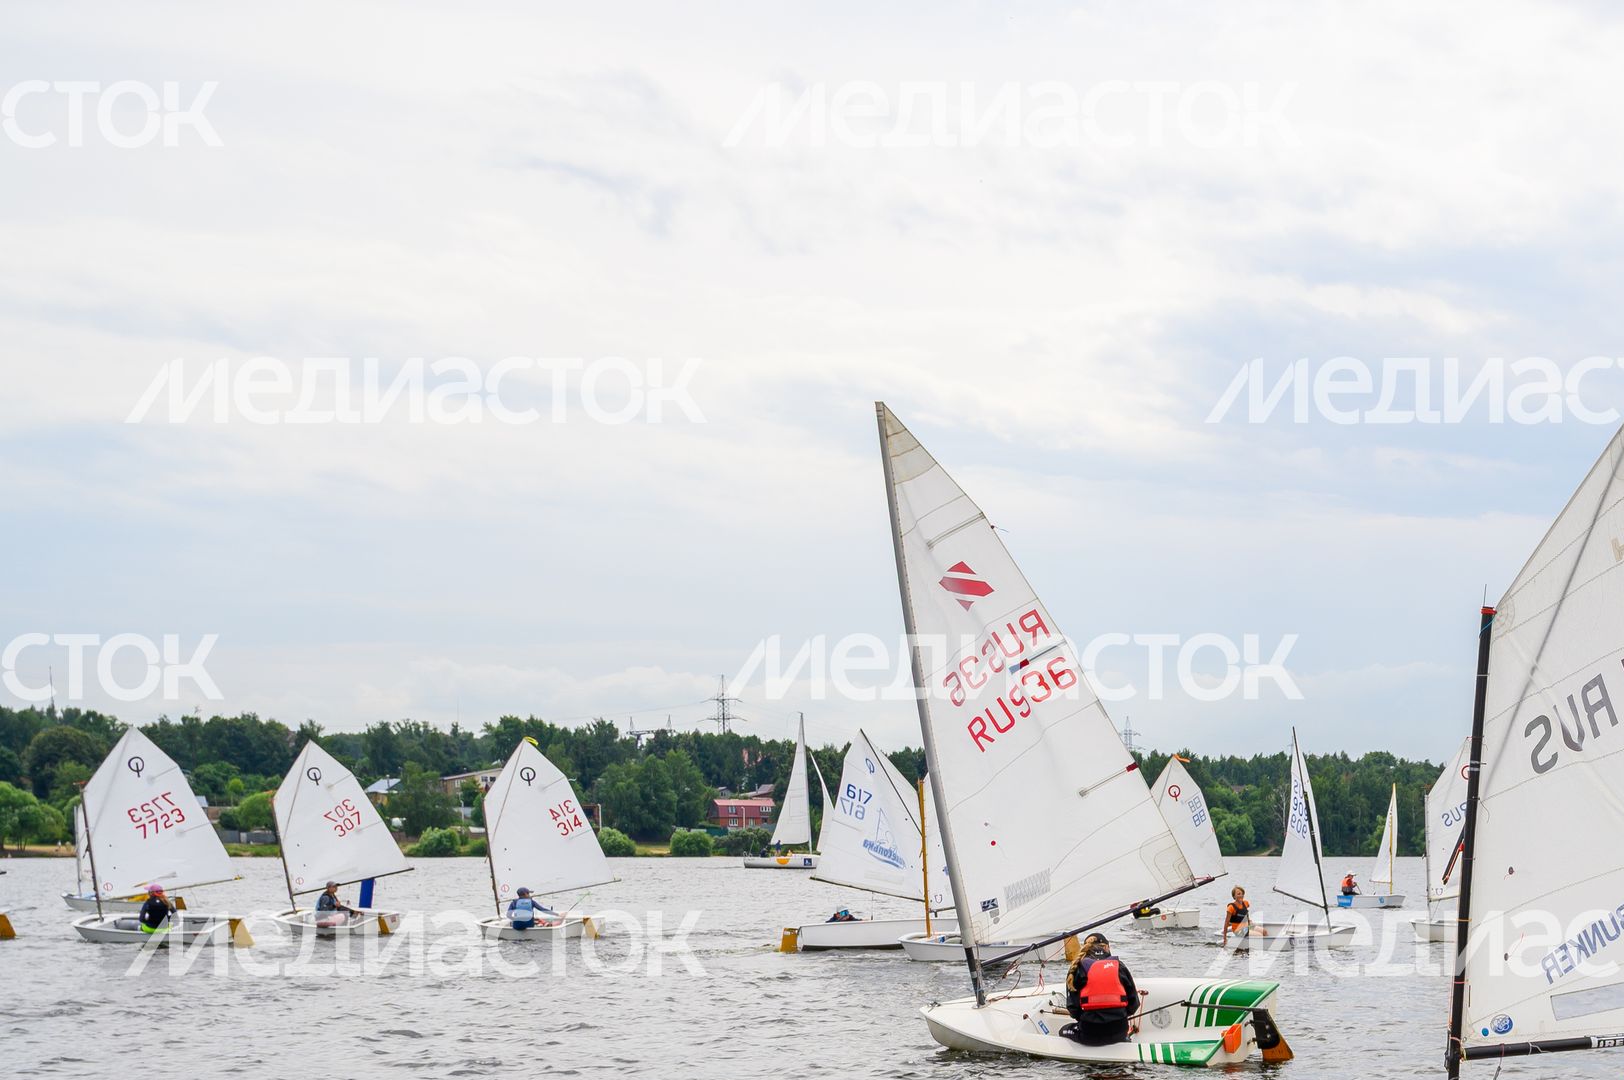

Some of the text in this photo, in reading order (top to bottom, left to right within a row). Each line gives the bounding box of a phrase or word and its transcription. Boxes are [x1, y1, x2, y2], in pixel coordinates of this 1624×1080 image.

[846, 783, 872, 805] 617
[136, 808, 185, 839] 7723
[334, 811, 361, 837] 307
[557, 814, 582, 836] 314
